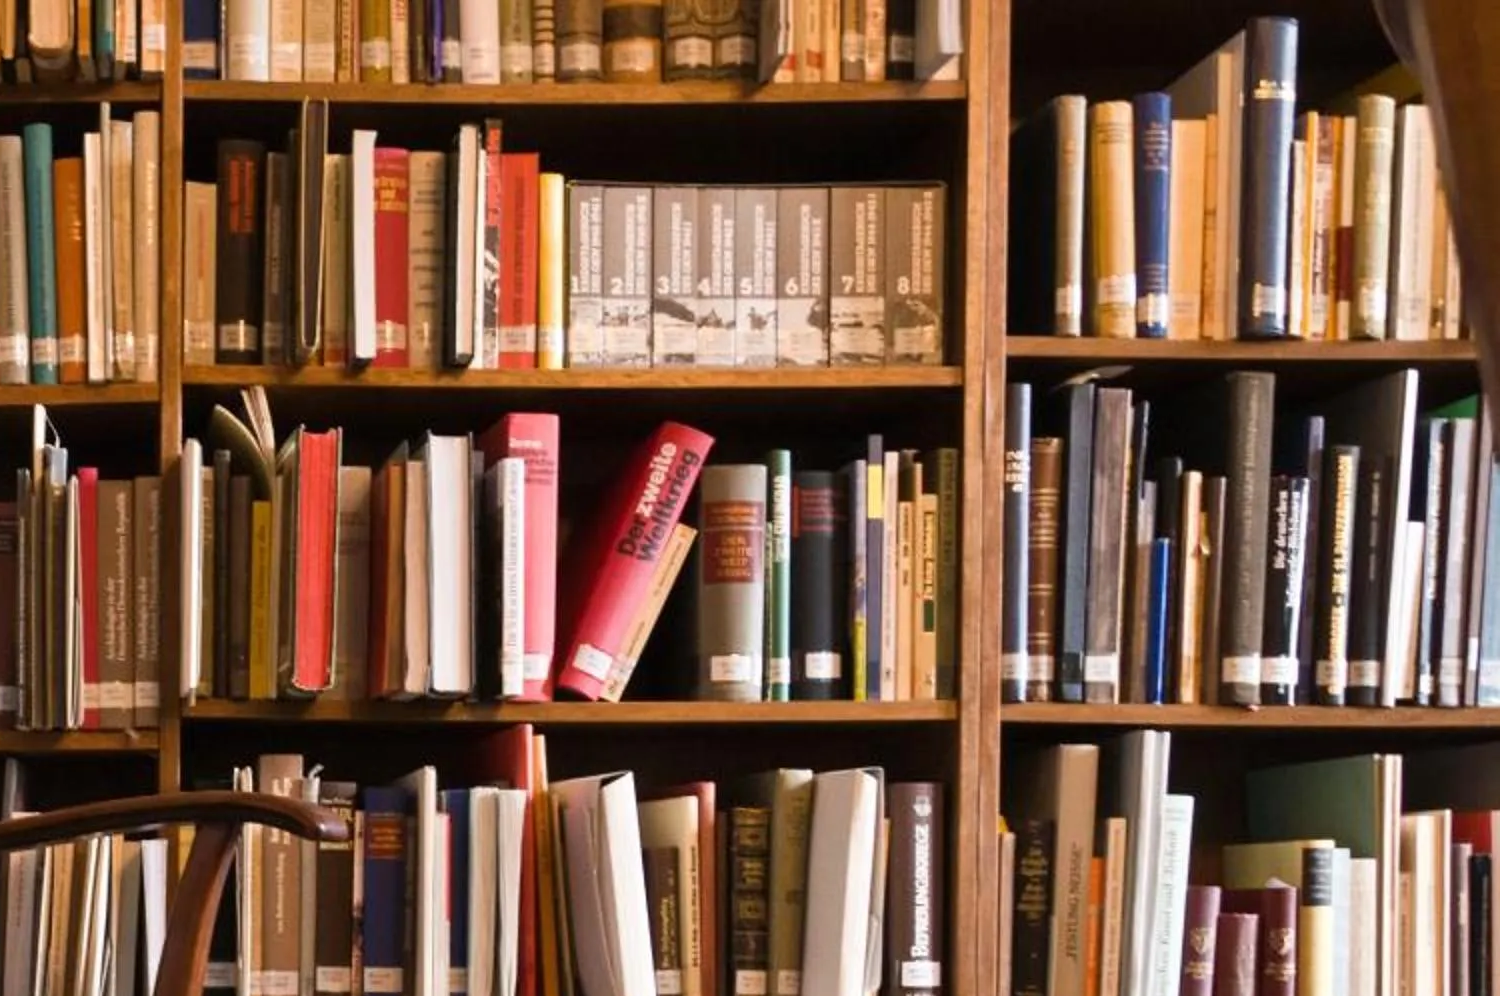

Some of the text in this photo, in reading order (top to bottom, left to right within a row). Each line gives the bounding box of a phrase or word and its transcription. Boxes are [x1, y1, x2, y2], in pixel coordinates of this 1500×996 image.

[612, 277, 624, 296] 2
[657, 276, 669, 296] 3
[697, 277, 710, 296] 4
[740, 277, 752, 296] 5
[785, 276, 798, 296] 6
[841, 275, 855, 295] 7
[898, 276, 910, 295] 8
[618, 442, 678, 558] Der zweite
[637, 448, 701, 563] Weltkrieg
